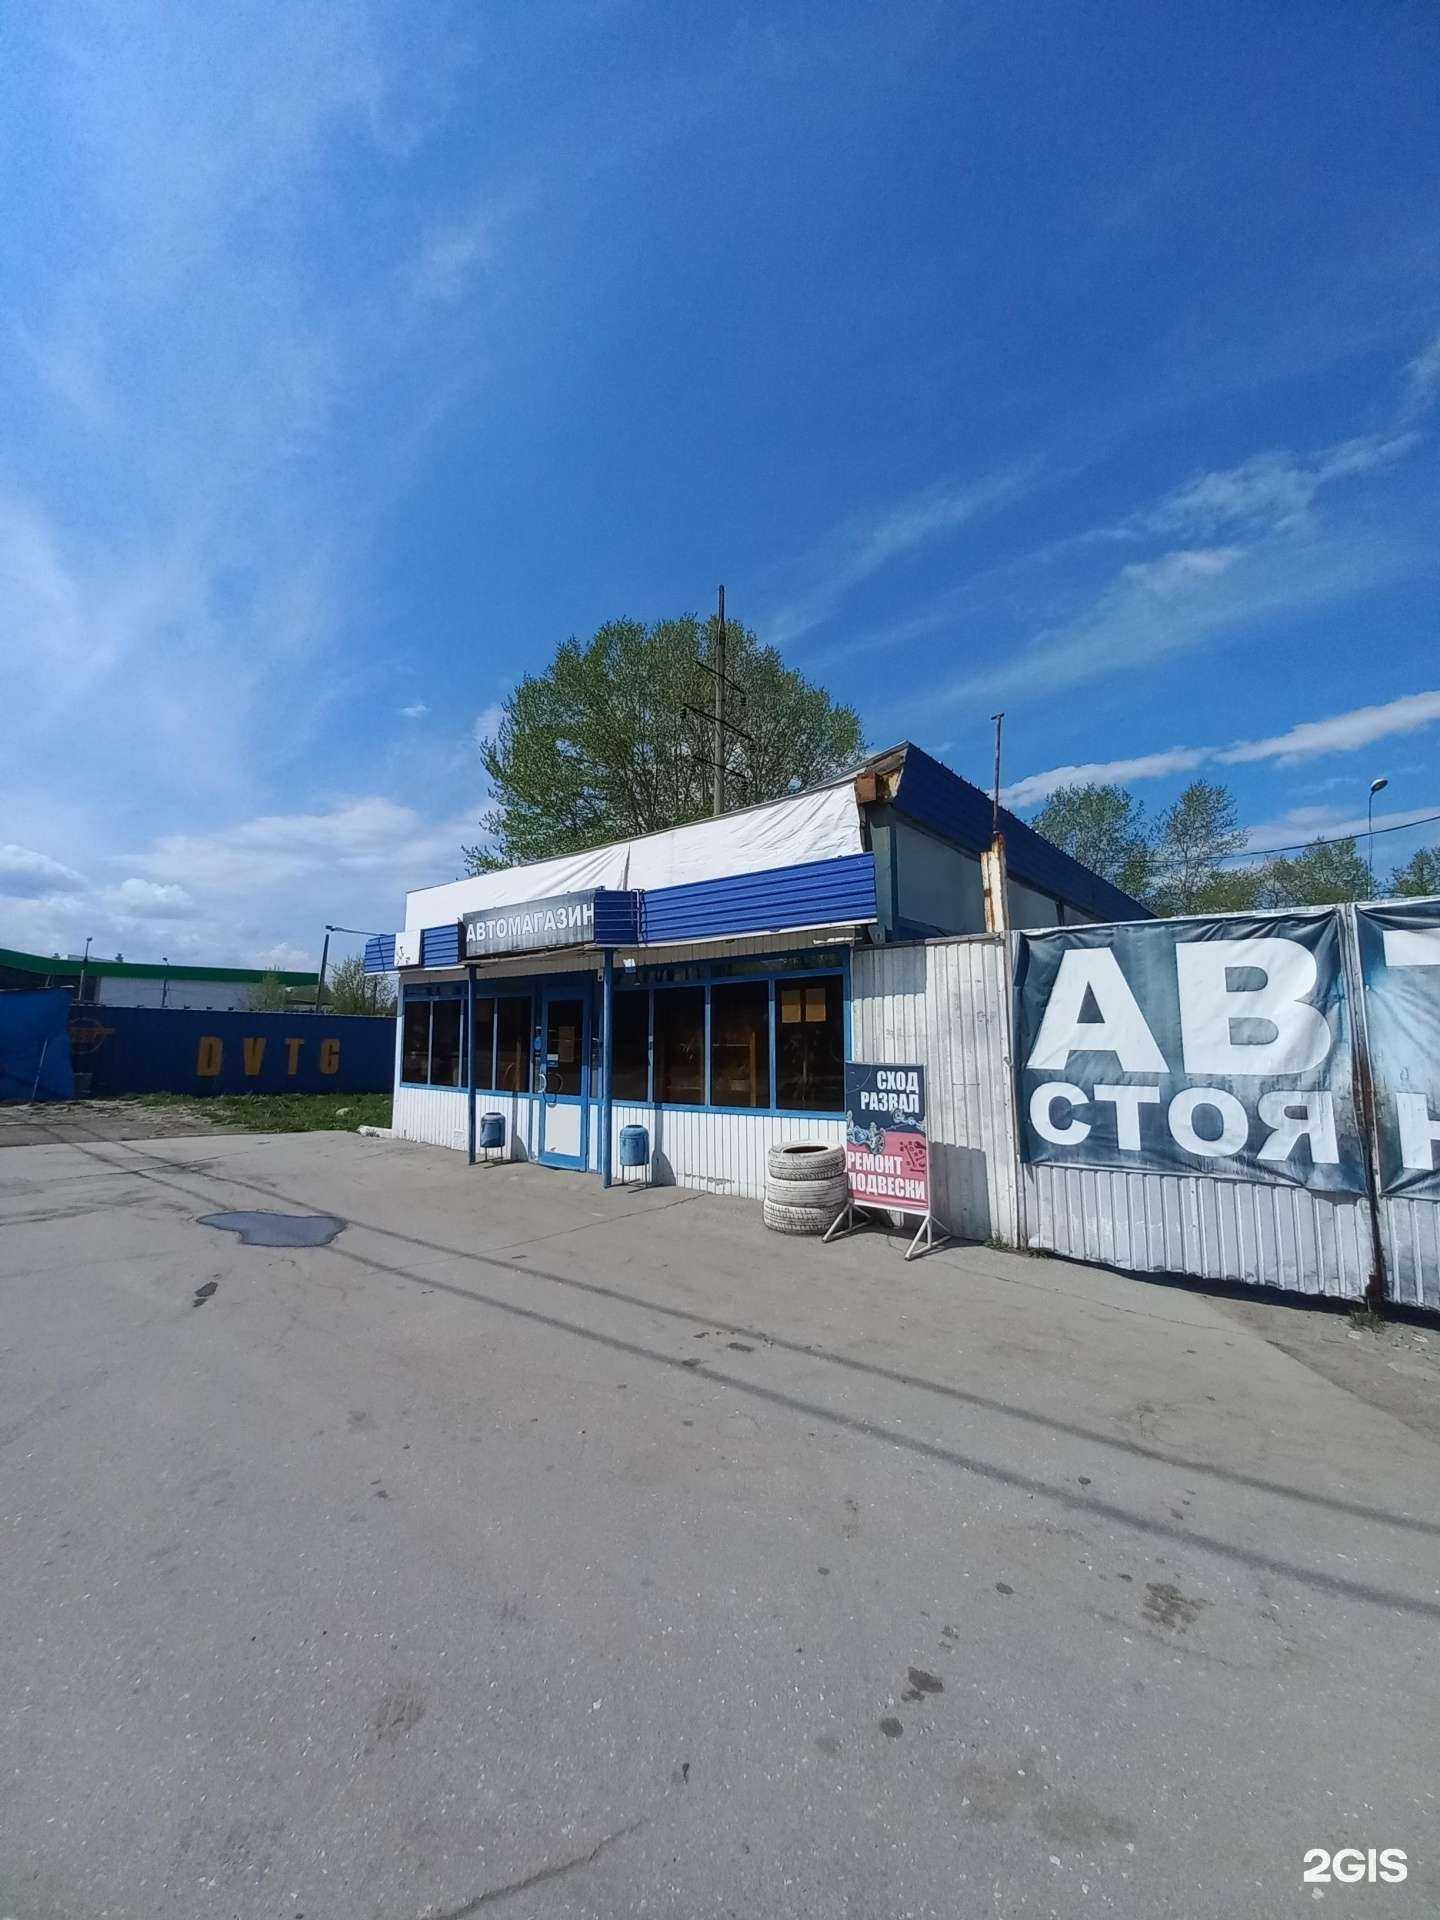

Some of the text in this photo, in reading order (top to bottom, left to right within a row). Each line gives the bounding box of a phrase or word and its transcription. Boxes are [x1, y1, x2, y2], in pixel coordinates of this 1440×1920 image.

[466, 902, 594, 942] АВТОМАГАЗИН
[197, 1036, 341, 1076] DVTG
[876, 1070, 919, 1094] СХОД
[860, 1091, 920, 1114] РАЗВАЛ
[847, 1150, 903, 1176] РЕМОНТ
[848, 1171, 926, 1200] ПОДВЕСКИ
